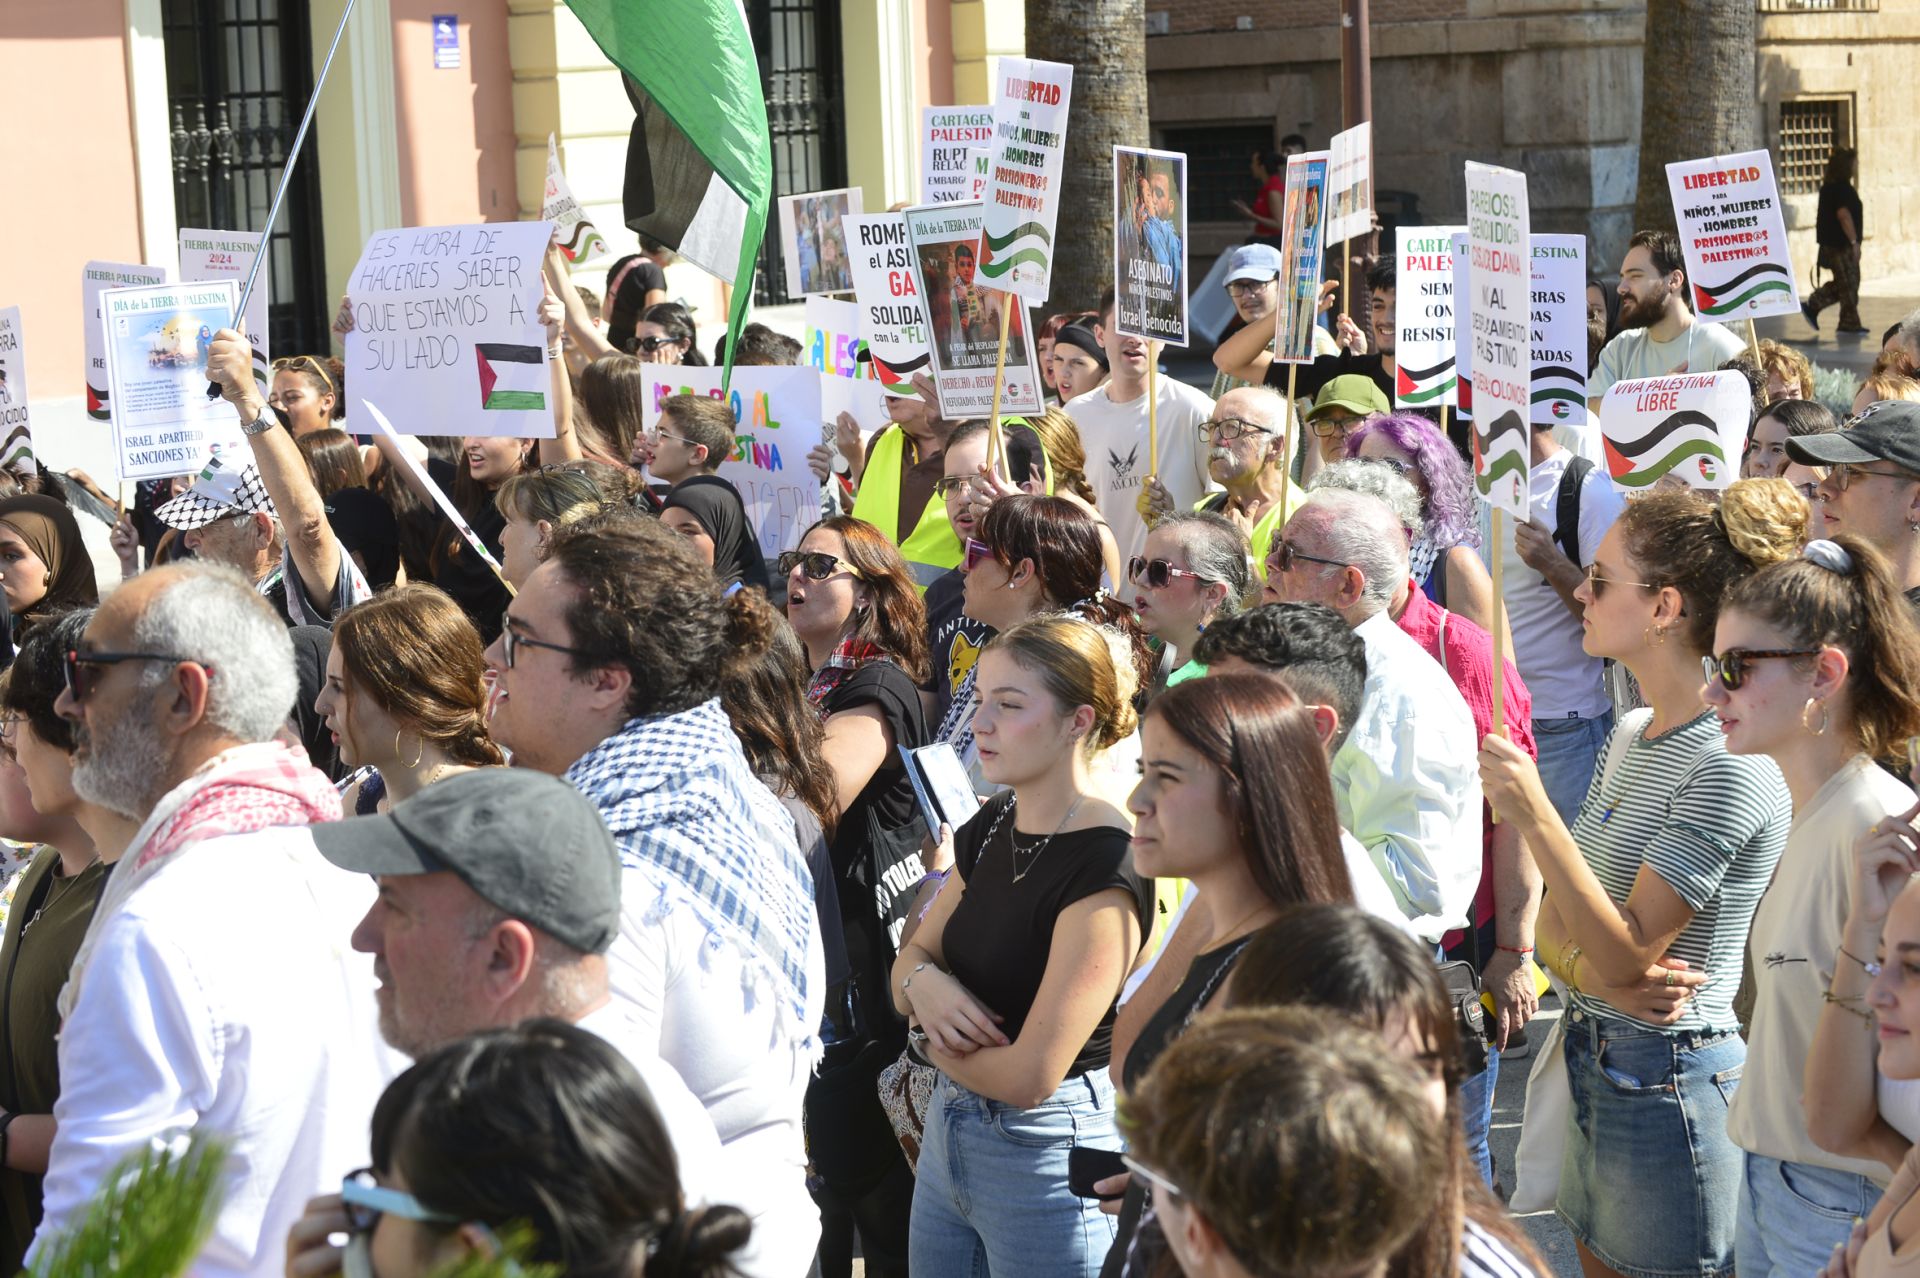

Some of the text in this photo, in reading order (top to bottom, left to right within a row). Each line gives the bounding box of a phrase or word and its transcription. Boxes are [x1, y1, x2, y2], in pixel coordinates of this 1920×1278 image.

[1005, 77, 1061, 106] LIBERTAD
[998, 121, 1060, 149] NIÑOS, MUJERES
[1005, 146, 1045, 168] HOMBRES
[995, 166, 1048, 191] PRISIONER@S
[1683, 166, 1760, 190] LIBERTAD
[995, 188, 1044, 212] PALESTIN@S
[1684, 198, 1771, 220] NIÑOS, MUJERES
[930, 222, 937, 234] de
[937, 221, 944, 233] la
[944, 219, 968, 233] TIERRA
[1472, 217, 1513, 246] GENOIDIO
[1703, 216, 1758, 232] HOMBRES
[184, 239, 213, 250] TIERRA
[369, 230, 503, 260] ES HORA DE
[1694, 230, 1769, 249] PRISIONER@S
[209, 253, 232, 264] 2024
[869, 252, 882, 268] el
[1701, 245, 1769, 264] PALESTIN@S
[87, 270, 161, 285] TIERRA PALESTINA
[359, 256, 522, 292] HACERLES SABER
[1128, 258, 1173, 285] ASESINATO
[888, 271, 917, 297] GA
[1144, 286, 1173, 302] PALESTINOS
[1421, 282, 1453, 296] SIEM
[114, 292, 227, 311] DÍA de la TIERRA PALESTINA
[357, 293, 526, 334] QUE ESTAMOS A
[871, 305, 924, 325] SOLIDA
[1120, 305, 1182, 335] Israel Genocida
[874, 332, 889, 343] con
[891, 331, 899, 343] la
[365, 334, 460, 370] SU LADO
[941, 377, 971, 390] DERECHO
[1489, 379, 1526, 406] OLONOS
[1615, 381, 1645, 395] VIVA
[1646, 375, 1717, 392] PALESTINA
[753, 389, 781, 429] AL
[1636, 392, 1679, 412] LIBRE
[125, 431, 203, 448] ISRAEL APARTHEID
[129, 448, 184, 466] SANCIONES
[939, 616, 987, 643] ANTI
